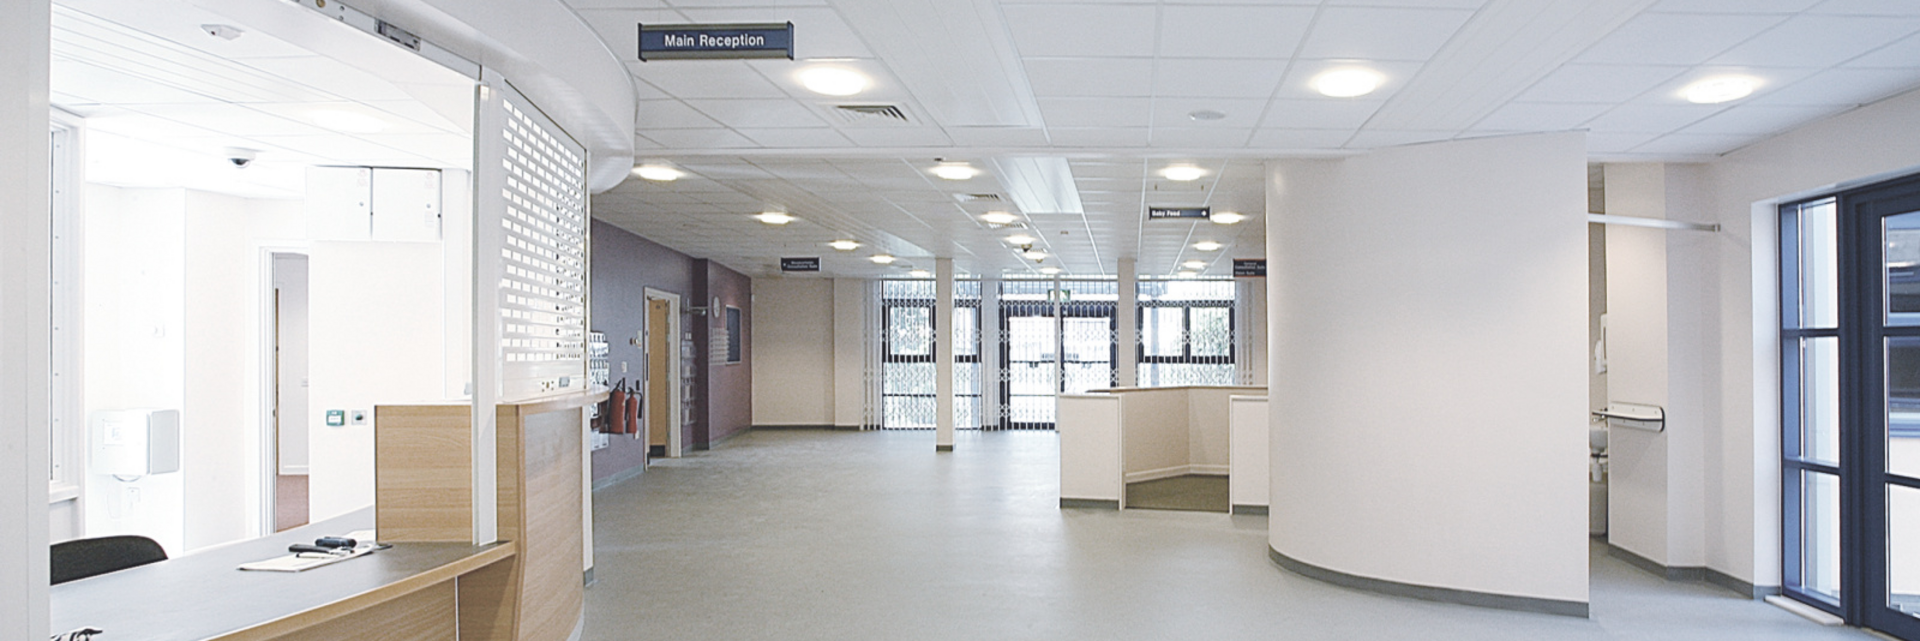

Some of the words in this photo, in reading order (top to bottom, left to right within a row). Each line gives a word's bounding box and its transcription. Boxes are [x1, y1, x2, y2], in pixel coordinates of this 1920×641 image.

[664, 34, 694, 47] Main
[699, 33, 764, 48] Reception
[1152, 210, 1166, 218] Baby
